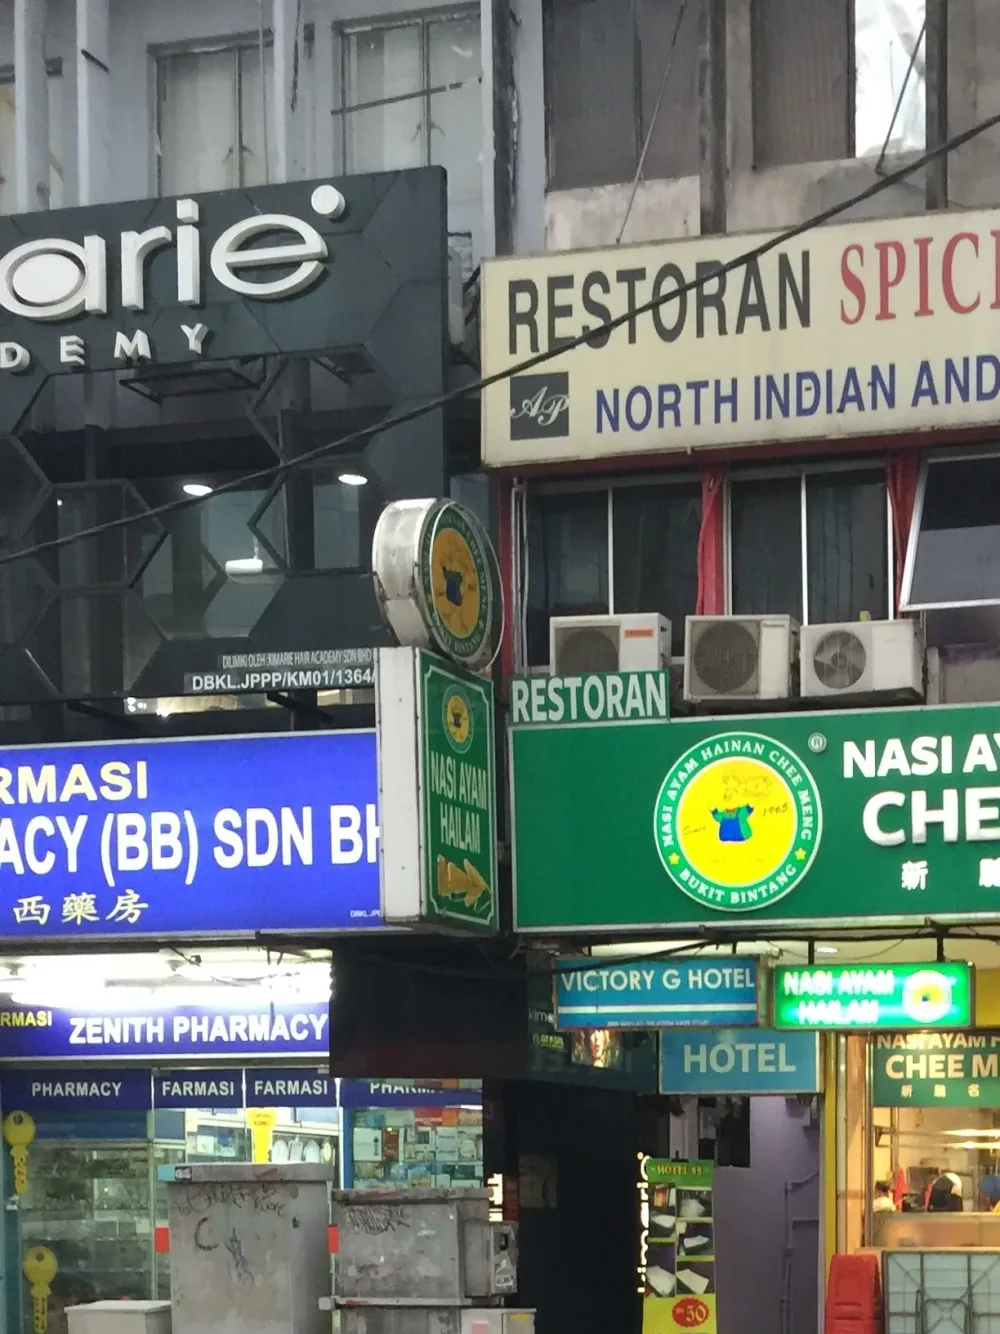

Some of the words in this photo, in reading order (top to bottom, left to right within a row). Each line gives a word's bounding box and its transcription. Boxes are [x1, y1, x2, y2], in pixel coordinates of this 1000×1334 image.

[509, 250, 811, 355] RESTORAN
[596, 378, 738, 433] NORTH
[754, 363, 895, 420] INDIAN
[512, 672, 667, 723] RESTORAN
[701, 739, 765, 762] HAINAN
[769, 750, 803, 787] CHEE
[843, 735, 953, 779] NASI
[431, 751, 457, 800] NASI
[459, 761, 487, 810] AYAM
[667, 758, 699, 801] AYAM
[440, 802, 480, 854] HAILAM
[661, 805, 675, 847] NASI
[797, 788, 814, 841] MENG
[100, 809, 199, 887] (BB)
[213, 806, 313, 868] SDN
[679, 867, 725, 902] BUKIT
[730, 864, 797, 904] BINTANG
[561, 969, 655, 992] VICTORY
[662, 968, 680, 990] G
[688, 968, 755, 989] HOTEL
[69, 1016, 164, 1044] ZENITH
[173, 1013, 329, 1042] PHARMACY
[683, 1042, 796, 1074] HOTEL
[885, 1054, 965, 1079] CHEE
[32, 1081, 122, 1097] PHARMACY
[162, 1080, 235, 1096] FARMASI
[254, 1080, 328, 1096] FARMASI
[686, 1305, 706, 1322] 50
